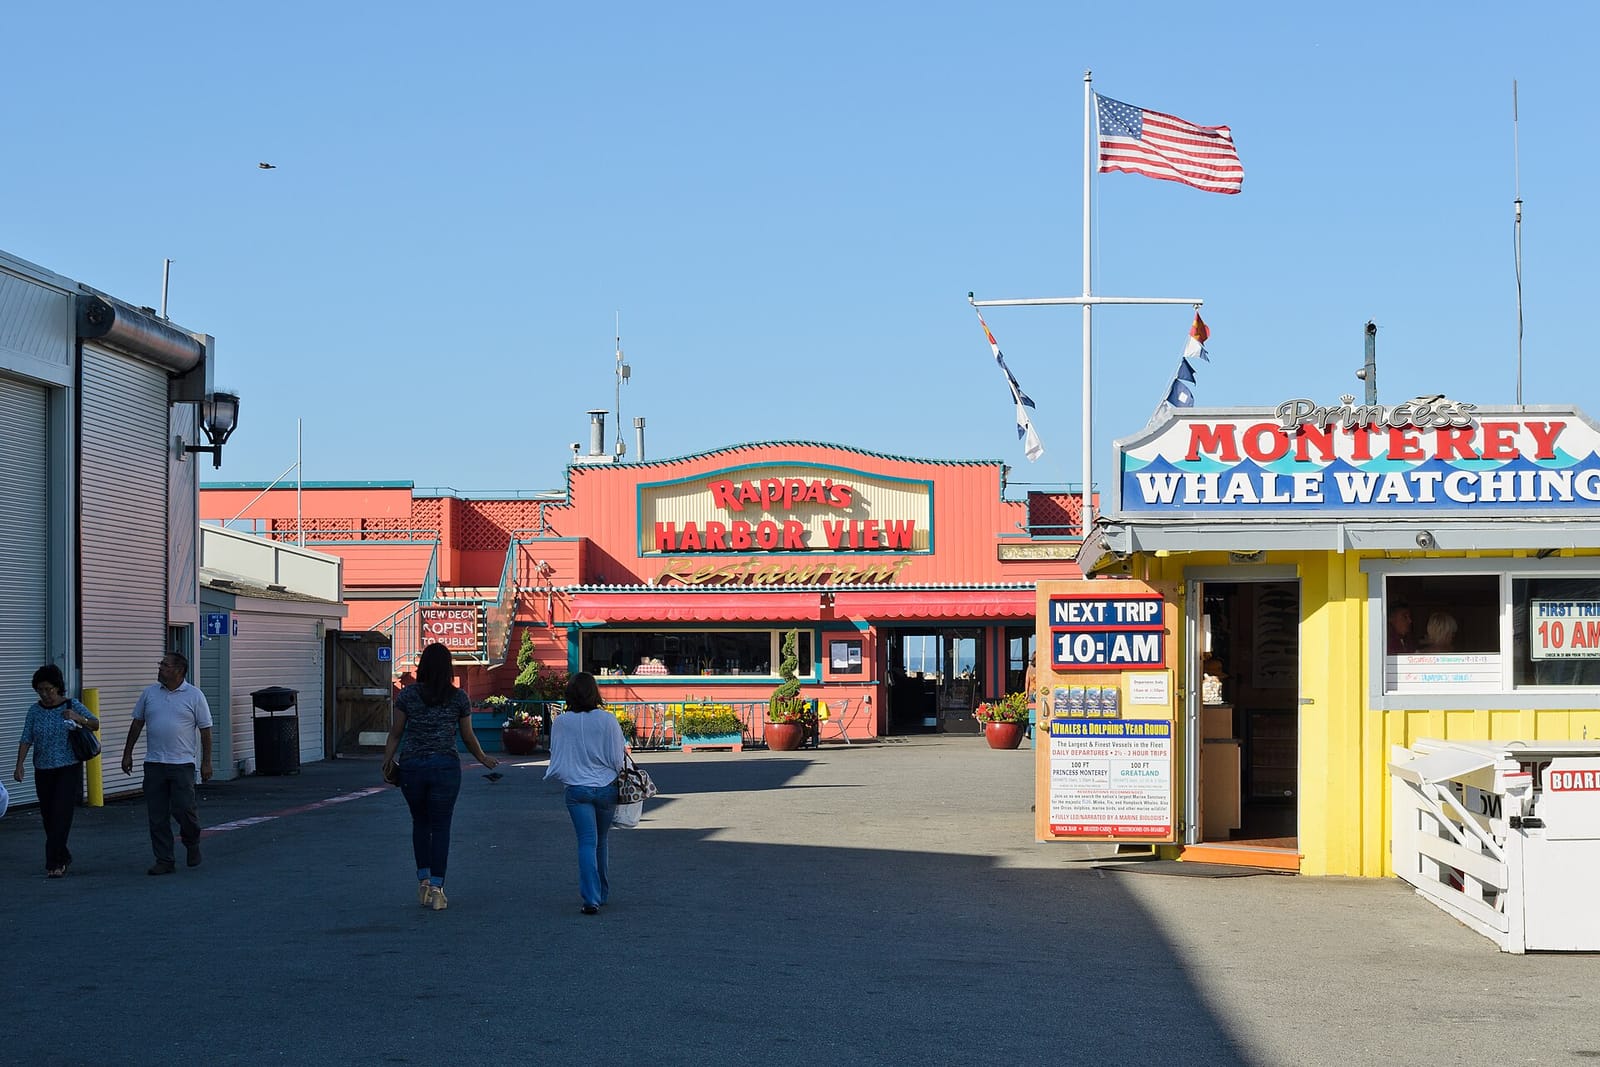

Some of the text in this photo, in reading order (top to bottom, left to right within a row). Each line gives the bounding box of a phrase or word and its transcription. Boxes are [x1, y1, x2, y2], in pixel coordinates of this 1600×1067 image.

[1275, 398, 1477, 430] Princess
[1185, 422, 1567, 461] MONTEREY
[707, 478, 853, 512] RAPPA'S
[1136, 469, 1600, 504] WHALE WATCHING
[655, 519, 915, 550] HARBOR VIEW
[653, 556, 912, 587] Restaurant
[421, 610, 475, 619] VIEW DECK
[1055, 602, 1158, 622] NEXT TRIP
[1539, 602, 1573, 616] FIRST
[432, 622, 474, 635] OPEN
[438, 637, 475, 646] PUBLIC
[1538, 621, 1600, 649] 10 AM
[1058, 633, 1159, 662] 10: AM
[1052, 723, 1169, 735] WHALES & DOLPHINS YEAR ROUND
